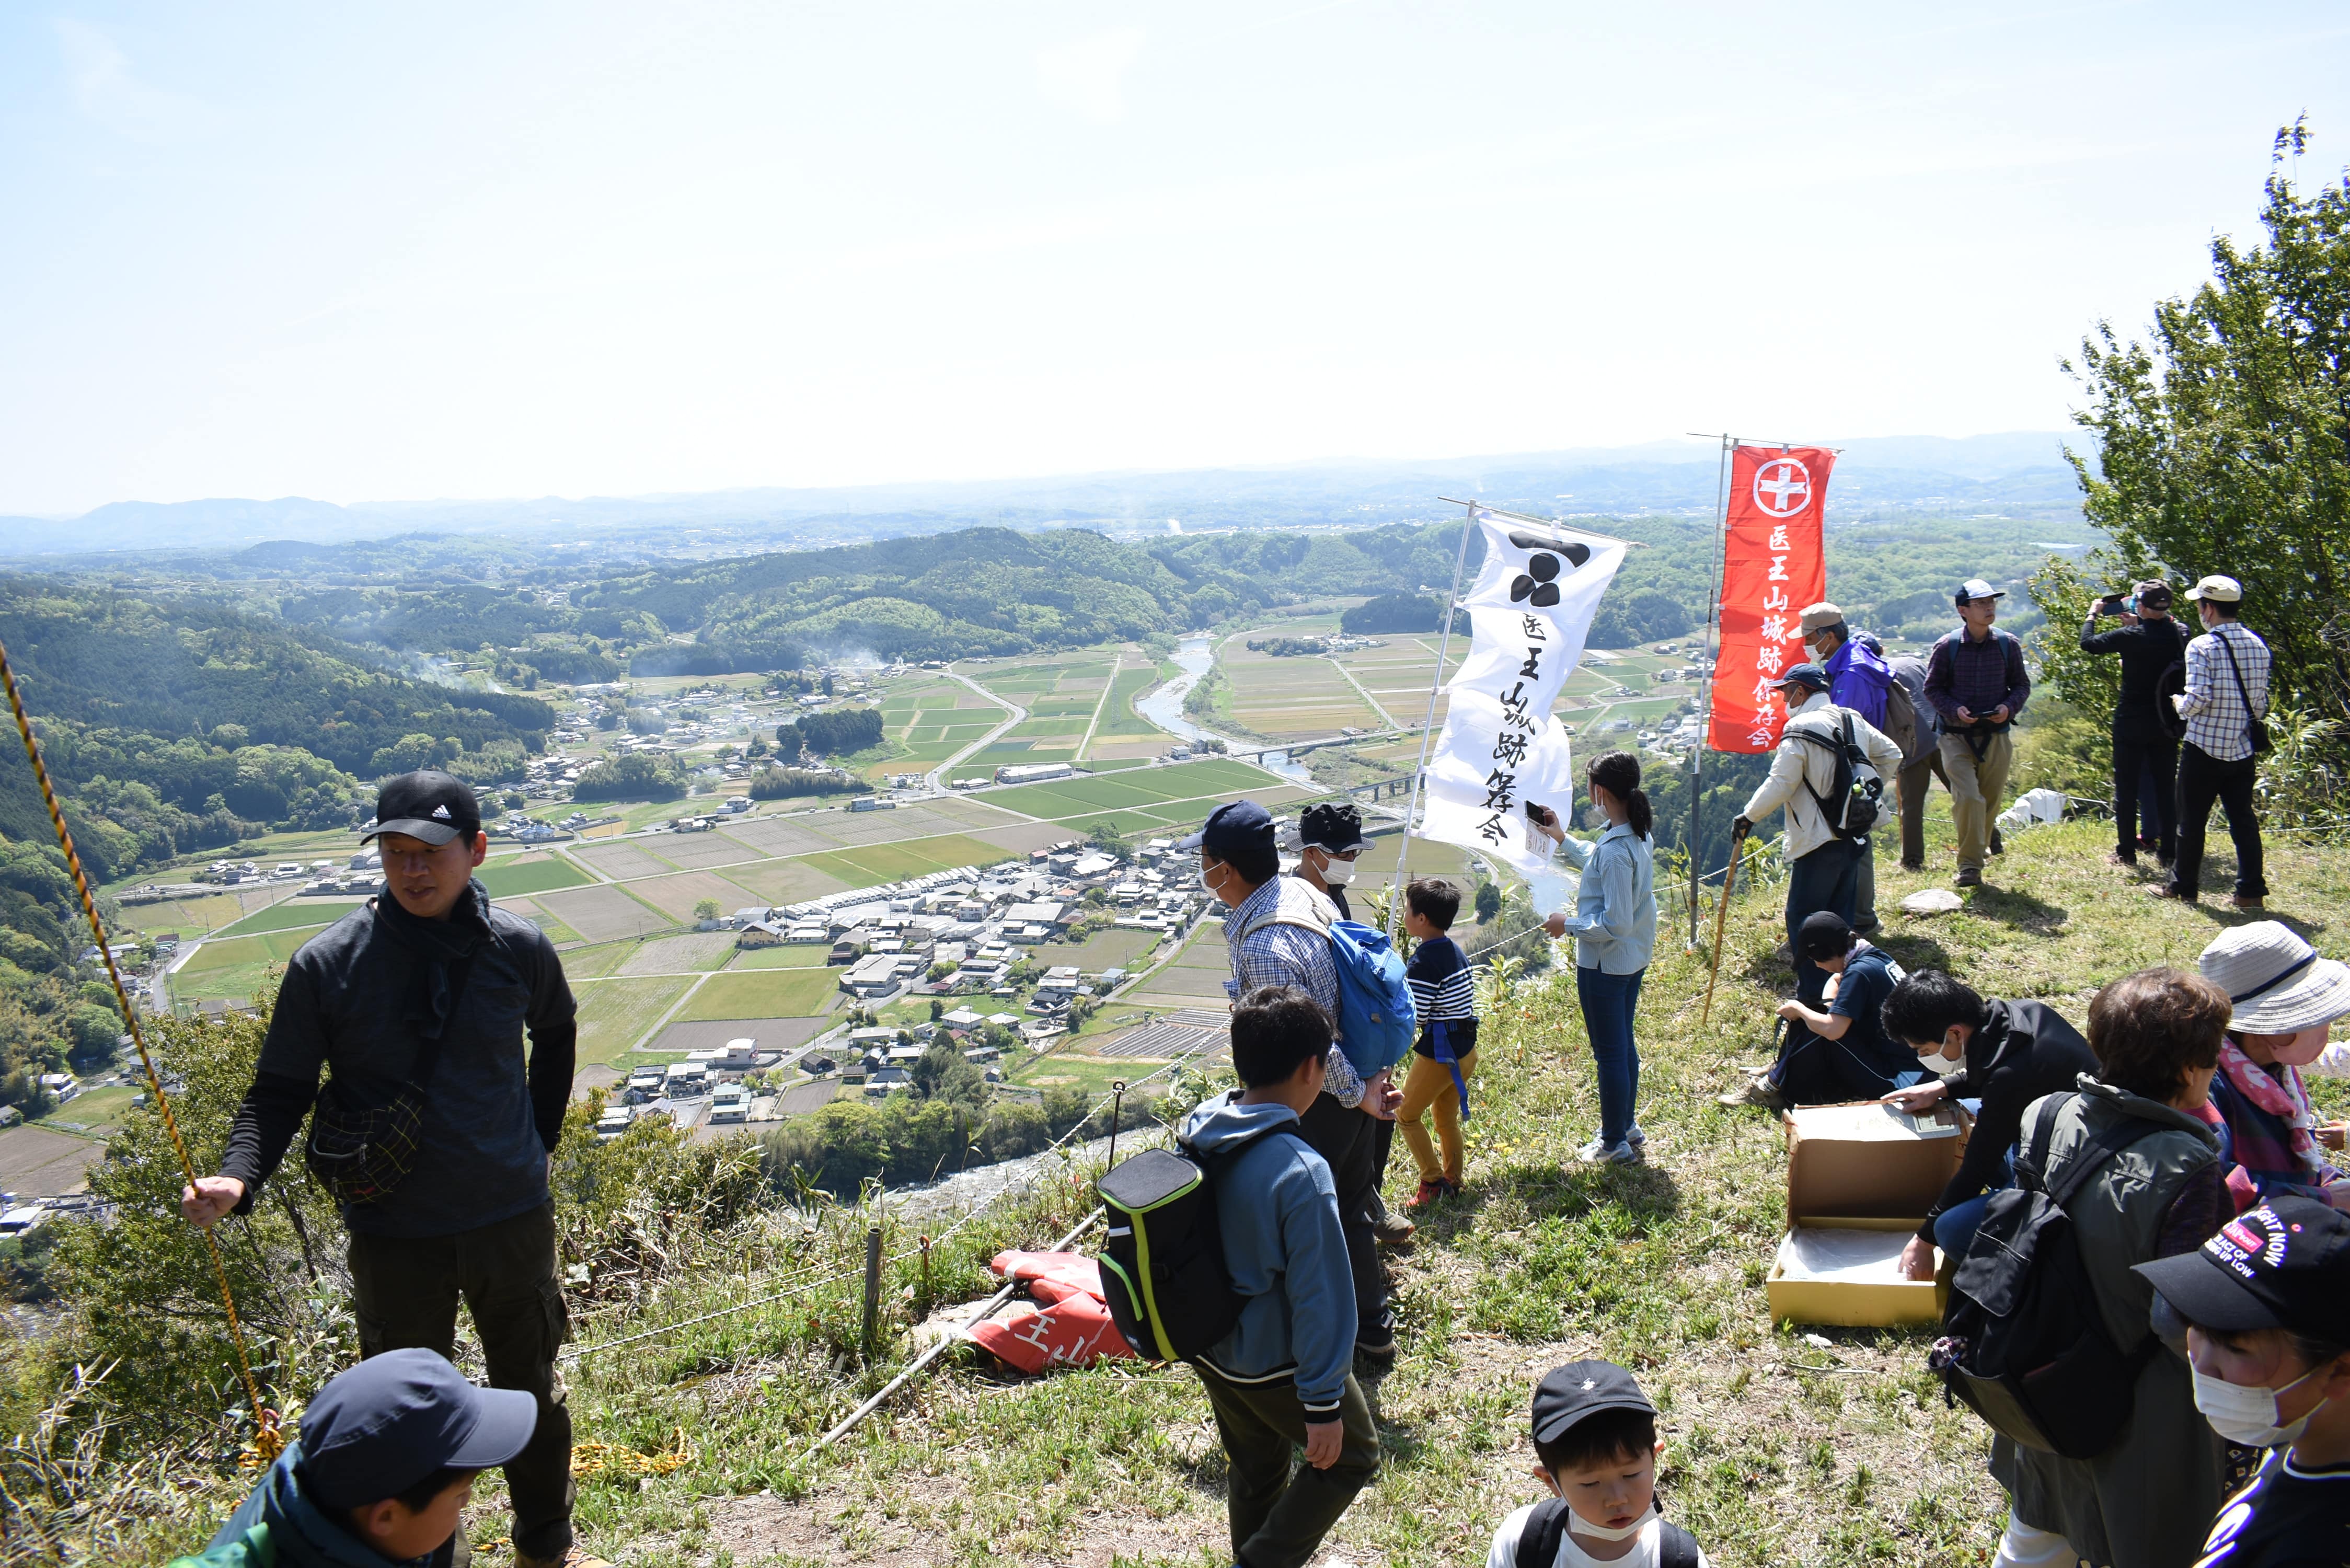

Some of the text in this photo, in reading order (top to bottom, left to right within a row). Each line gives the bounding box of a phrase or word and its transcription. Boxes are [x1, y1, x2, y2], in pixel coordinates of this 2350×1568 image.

[1746, 524, 1791, 748] 医王山城跡保存会
[2219, 1250, 2233, 1262] UP
[2230, 1259, 2255, 1277] LOW
[2233, 1249, 2249, 1261] OF
[2263, 1232, 2286, 1267] NOW
